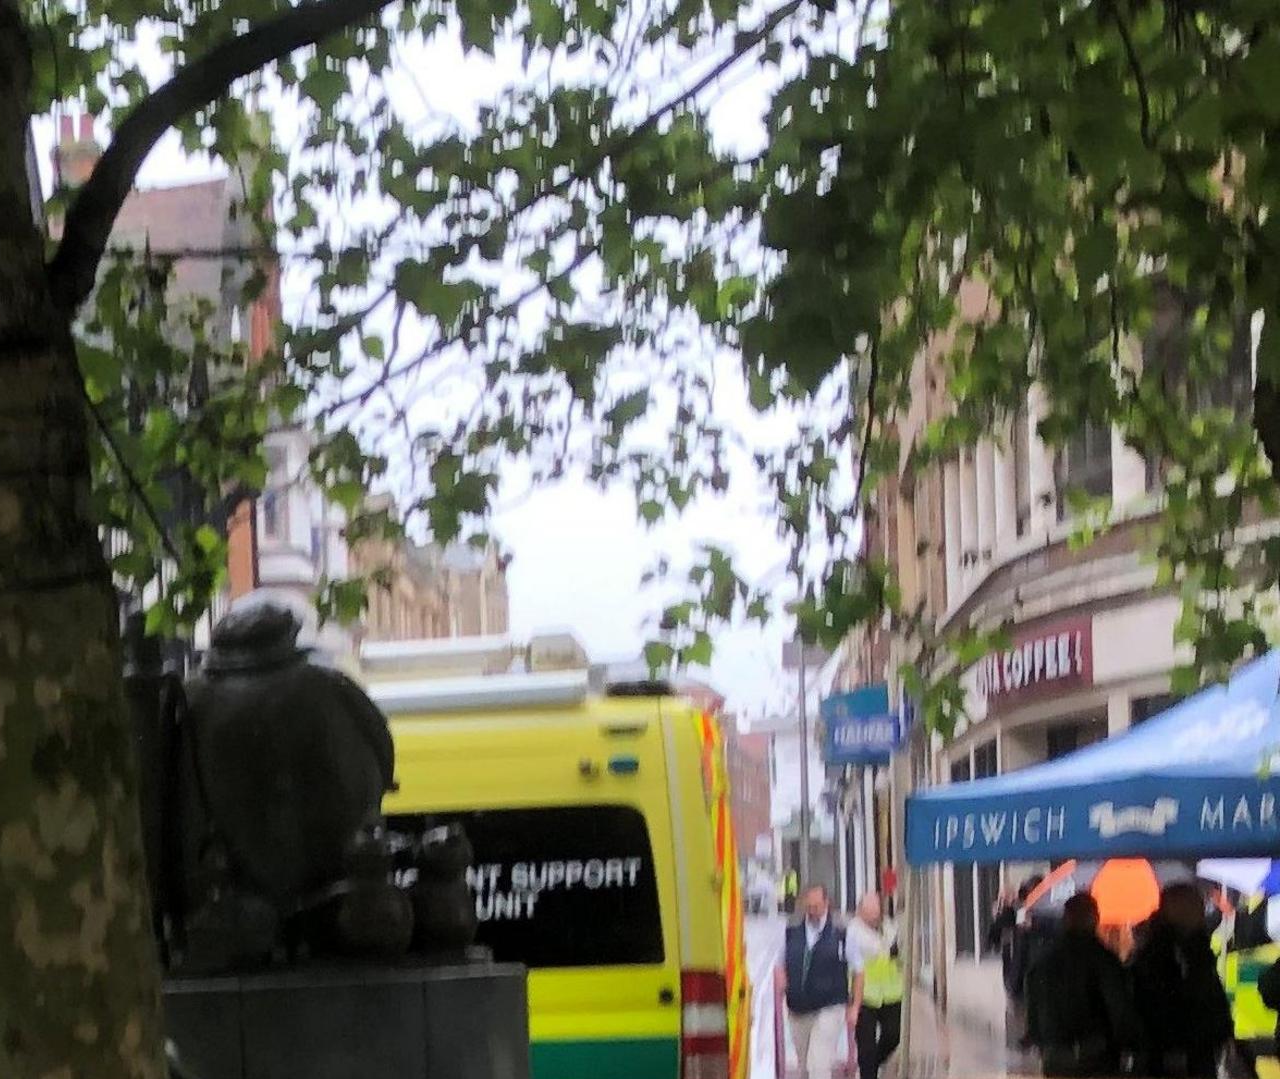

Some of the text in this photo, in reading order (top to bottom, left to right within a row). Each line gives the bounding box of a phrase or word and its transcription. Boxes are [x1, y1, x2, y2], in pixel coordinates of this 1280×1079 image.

[934, 806, 1065, 849] IPSWICH
[511, 857, 640, 890] SUPPORT
[474, 890, 538, 921] UNIT
